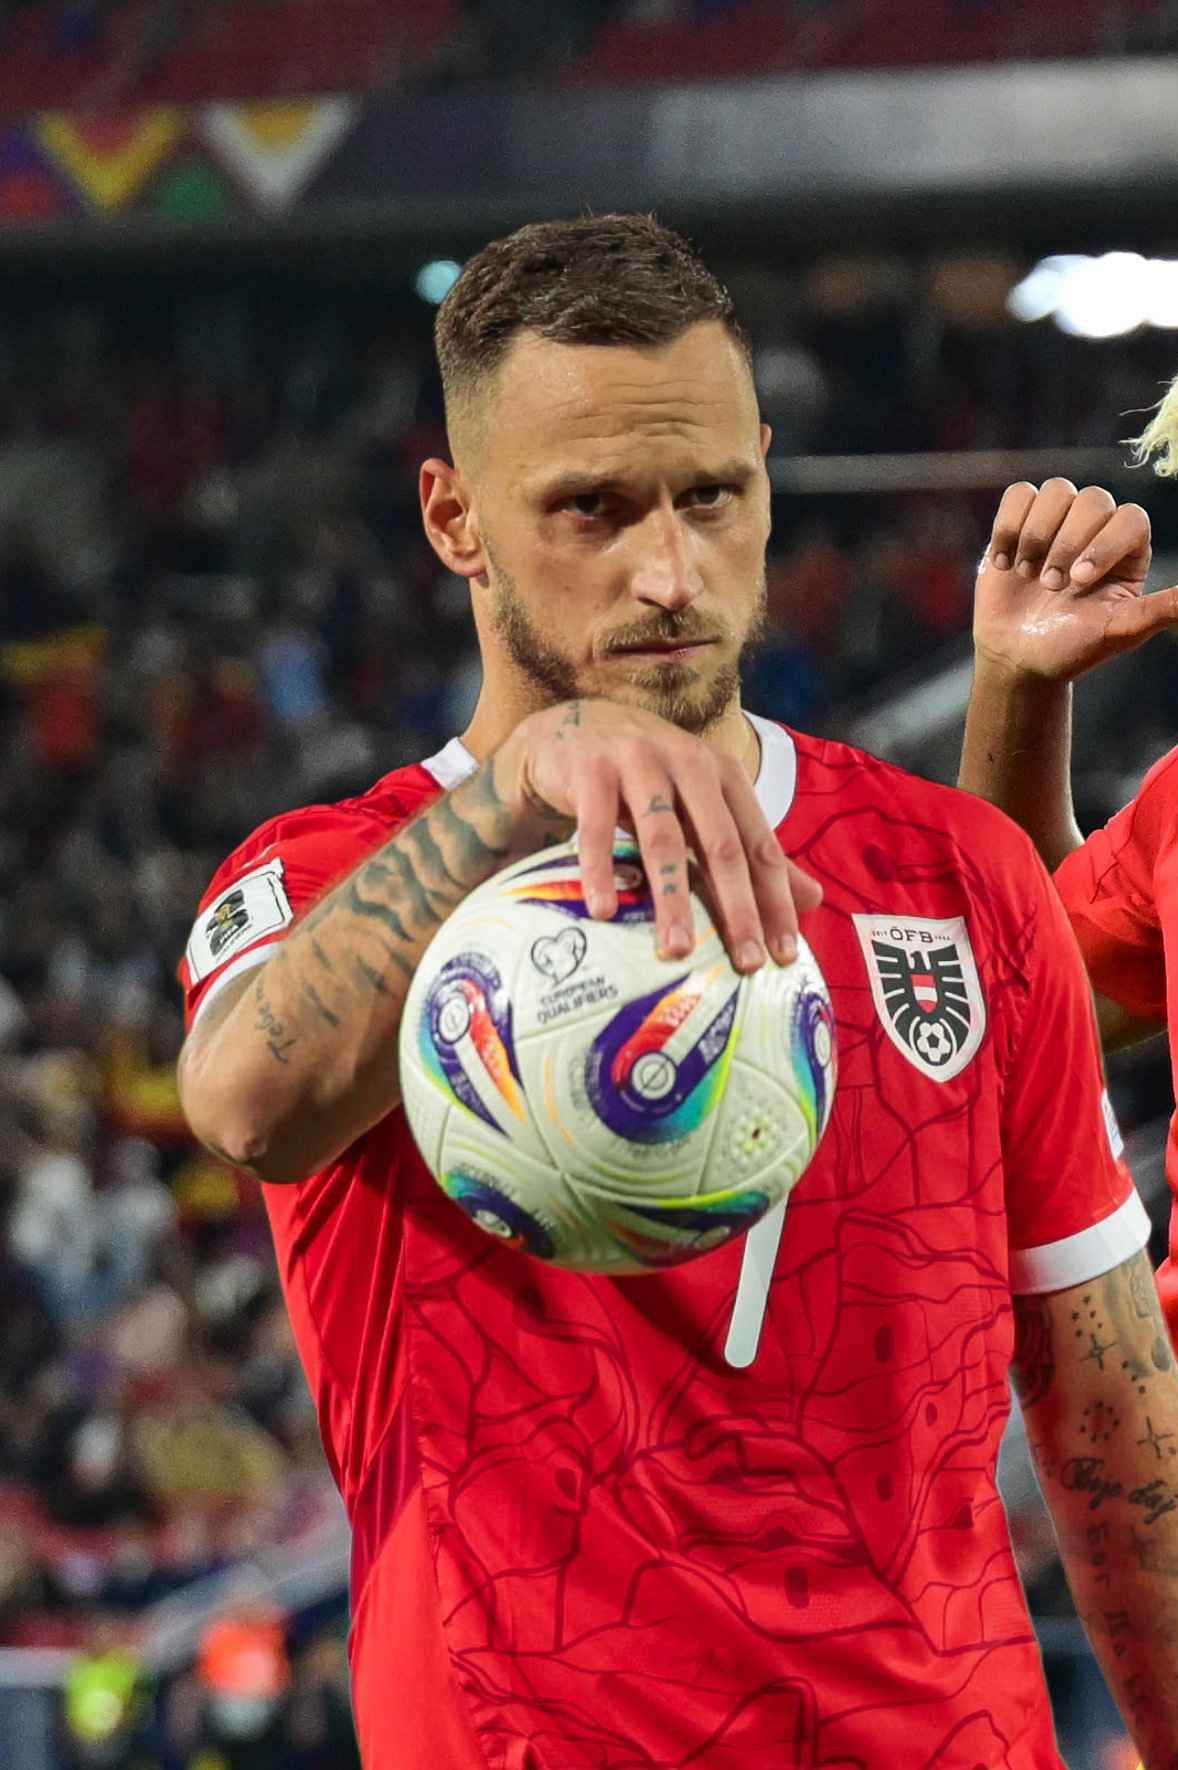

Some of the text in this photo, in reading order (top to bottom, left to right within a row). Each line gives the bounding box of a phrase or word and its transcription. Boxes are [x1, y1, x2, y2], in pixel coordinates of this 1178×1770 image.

[890, 926, 934, 943] ÖFB
[537, 984, 619, 1024] QUALIFIERS
[540, 975, 606, 1005] EUROPEAN
